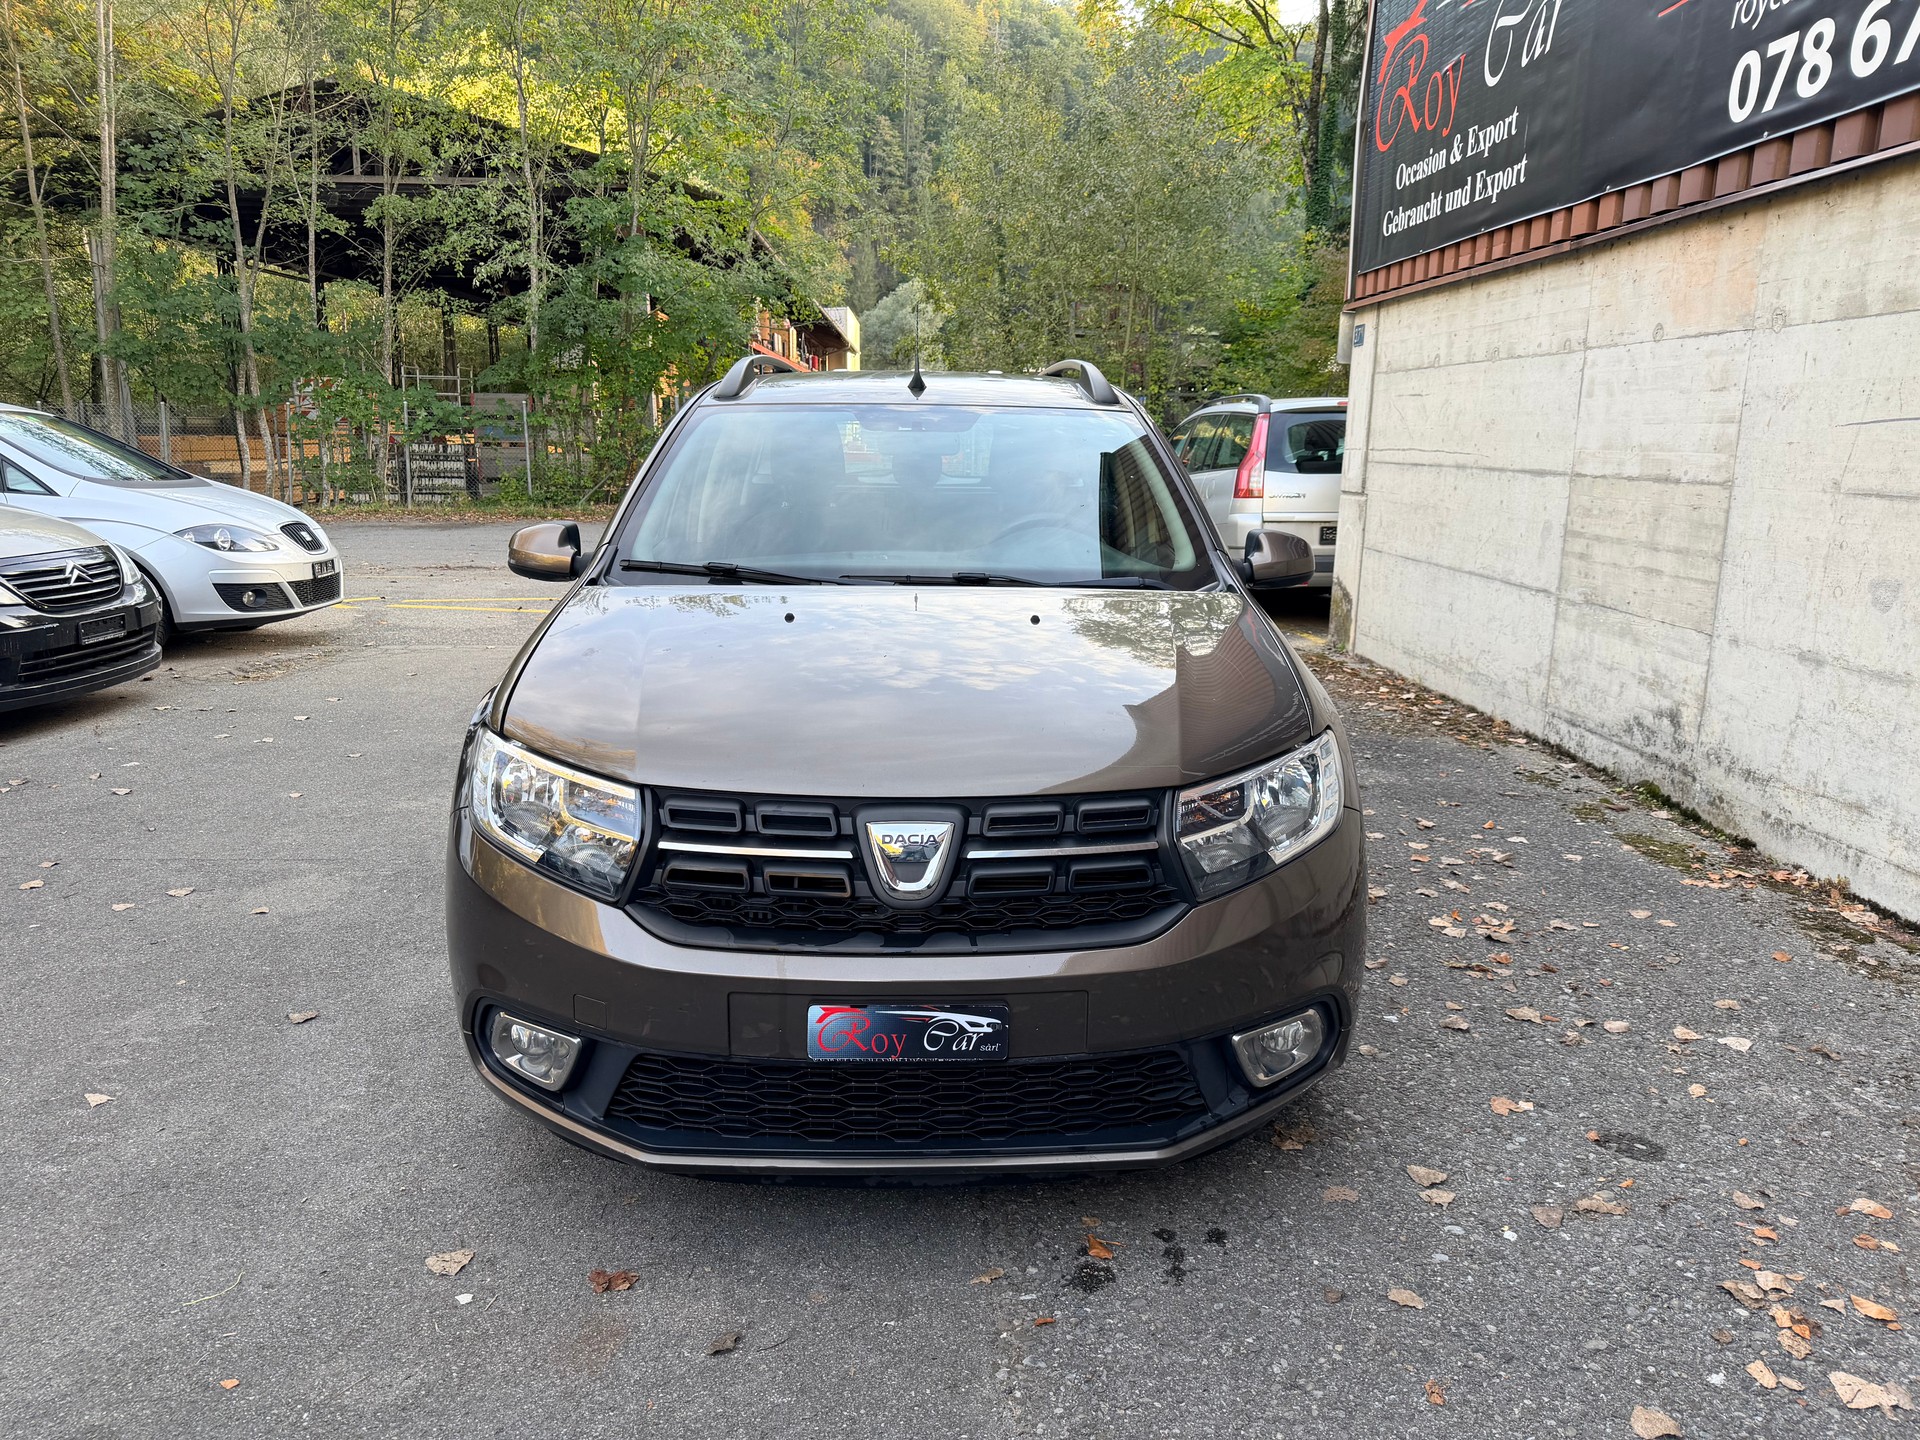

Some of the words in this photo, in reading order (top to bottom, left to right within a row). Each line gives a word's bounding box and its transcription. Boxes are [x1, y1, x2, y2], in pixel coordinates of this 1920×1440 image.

[1376, 33, 1467, 151] Roy
[1728, 17, 1836, 123] 078
[1395, 147, 1447, 190] Occasion
[1450, 133, 1464, 165] &
[1465, 105, 1519, 158] Export
[1382, 190, 1443, 237] Gebraucht
[1445, 176, 1471, 213] und
[1473, 152, 1528, 204] Export
[881, 834, 938, 845] DACIA
[817, 1015, 907, 1060] Roy
[923, 1020, 984, 1051] Car
